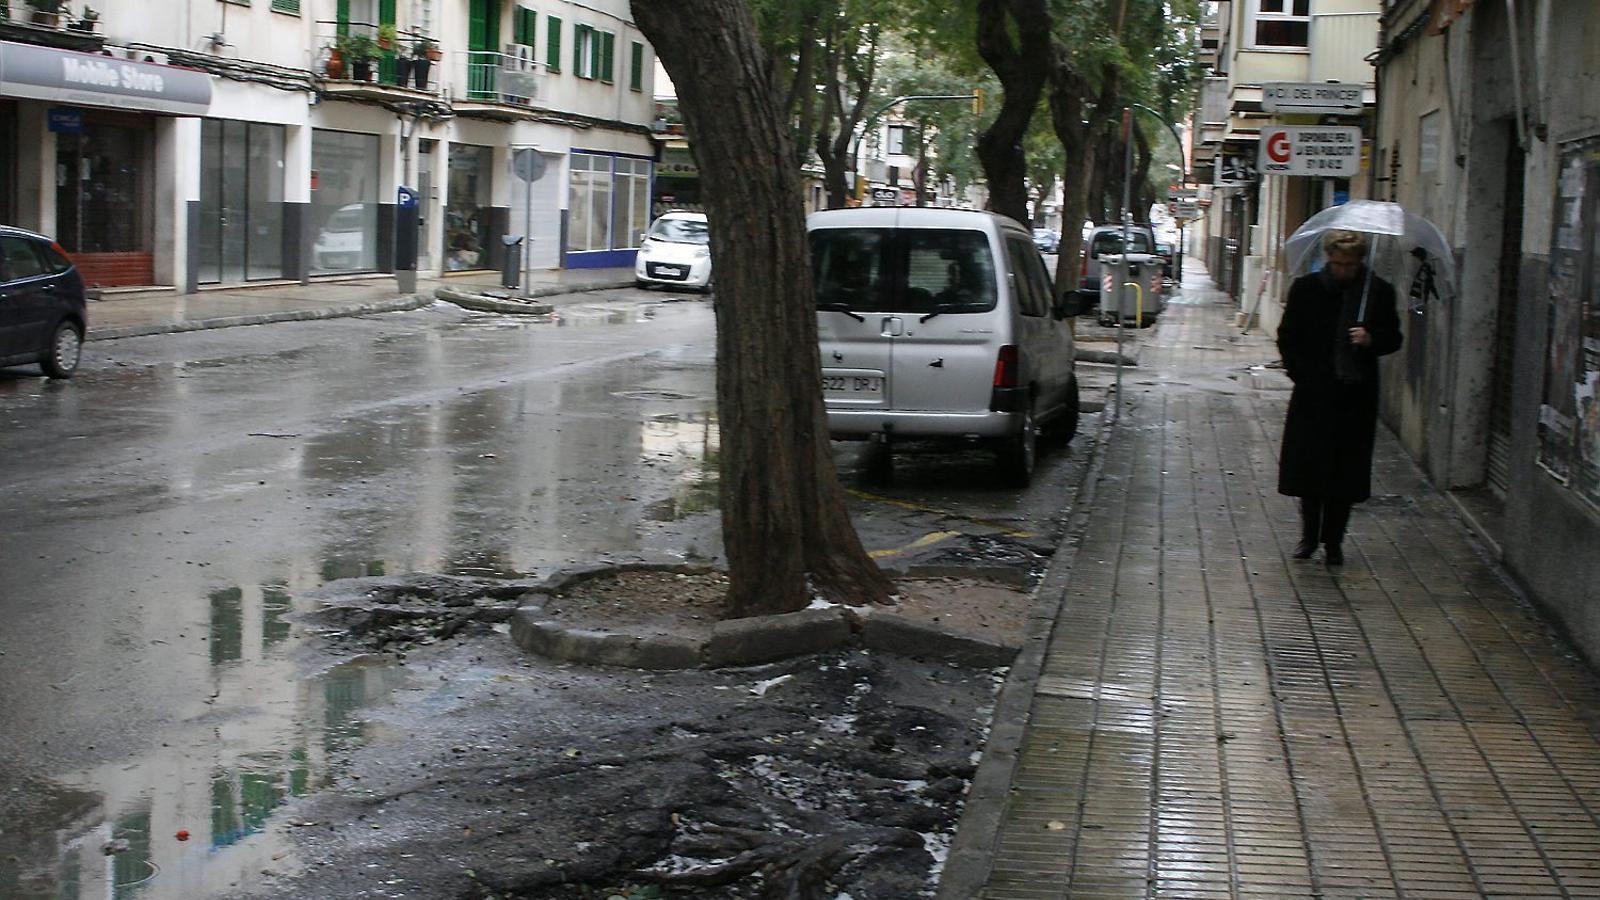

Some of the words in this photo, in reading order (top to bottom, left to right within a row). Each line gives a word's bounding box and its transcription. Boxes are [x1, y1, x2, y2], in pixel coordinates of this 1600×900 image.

[62, 57, 119, 87] Mobile
[121, 64, 164, 92] Store
[1294, 88, 1312, 99] DEL
[399, 192, 411, 205] P
